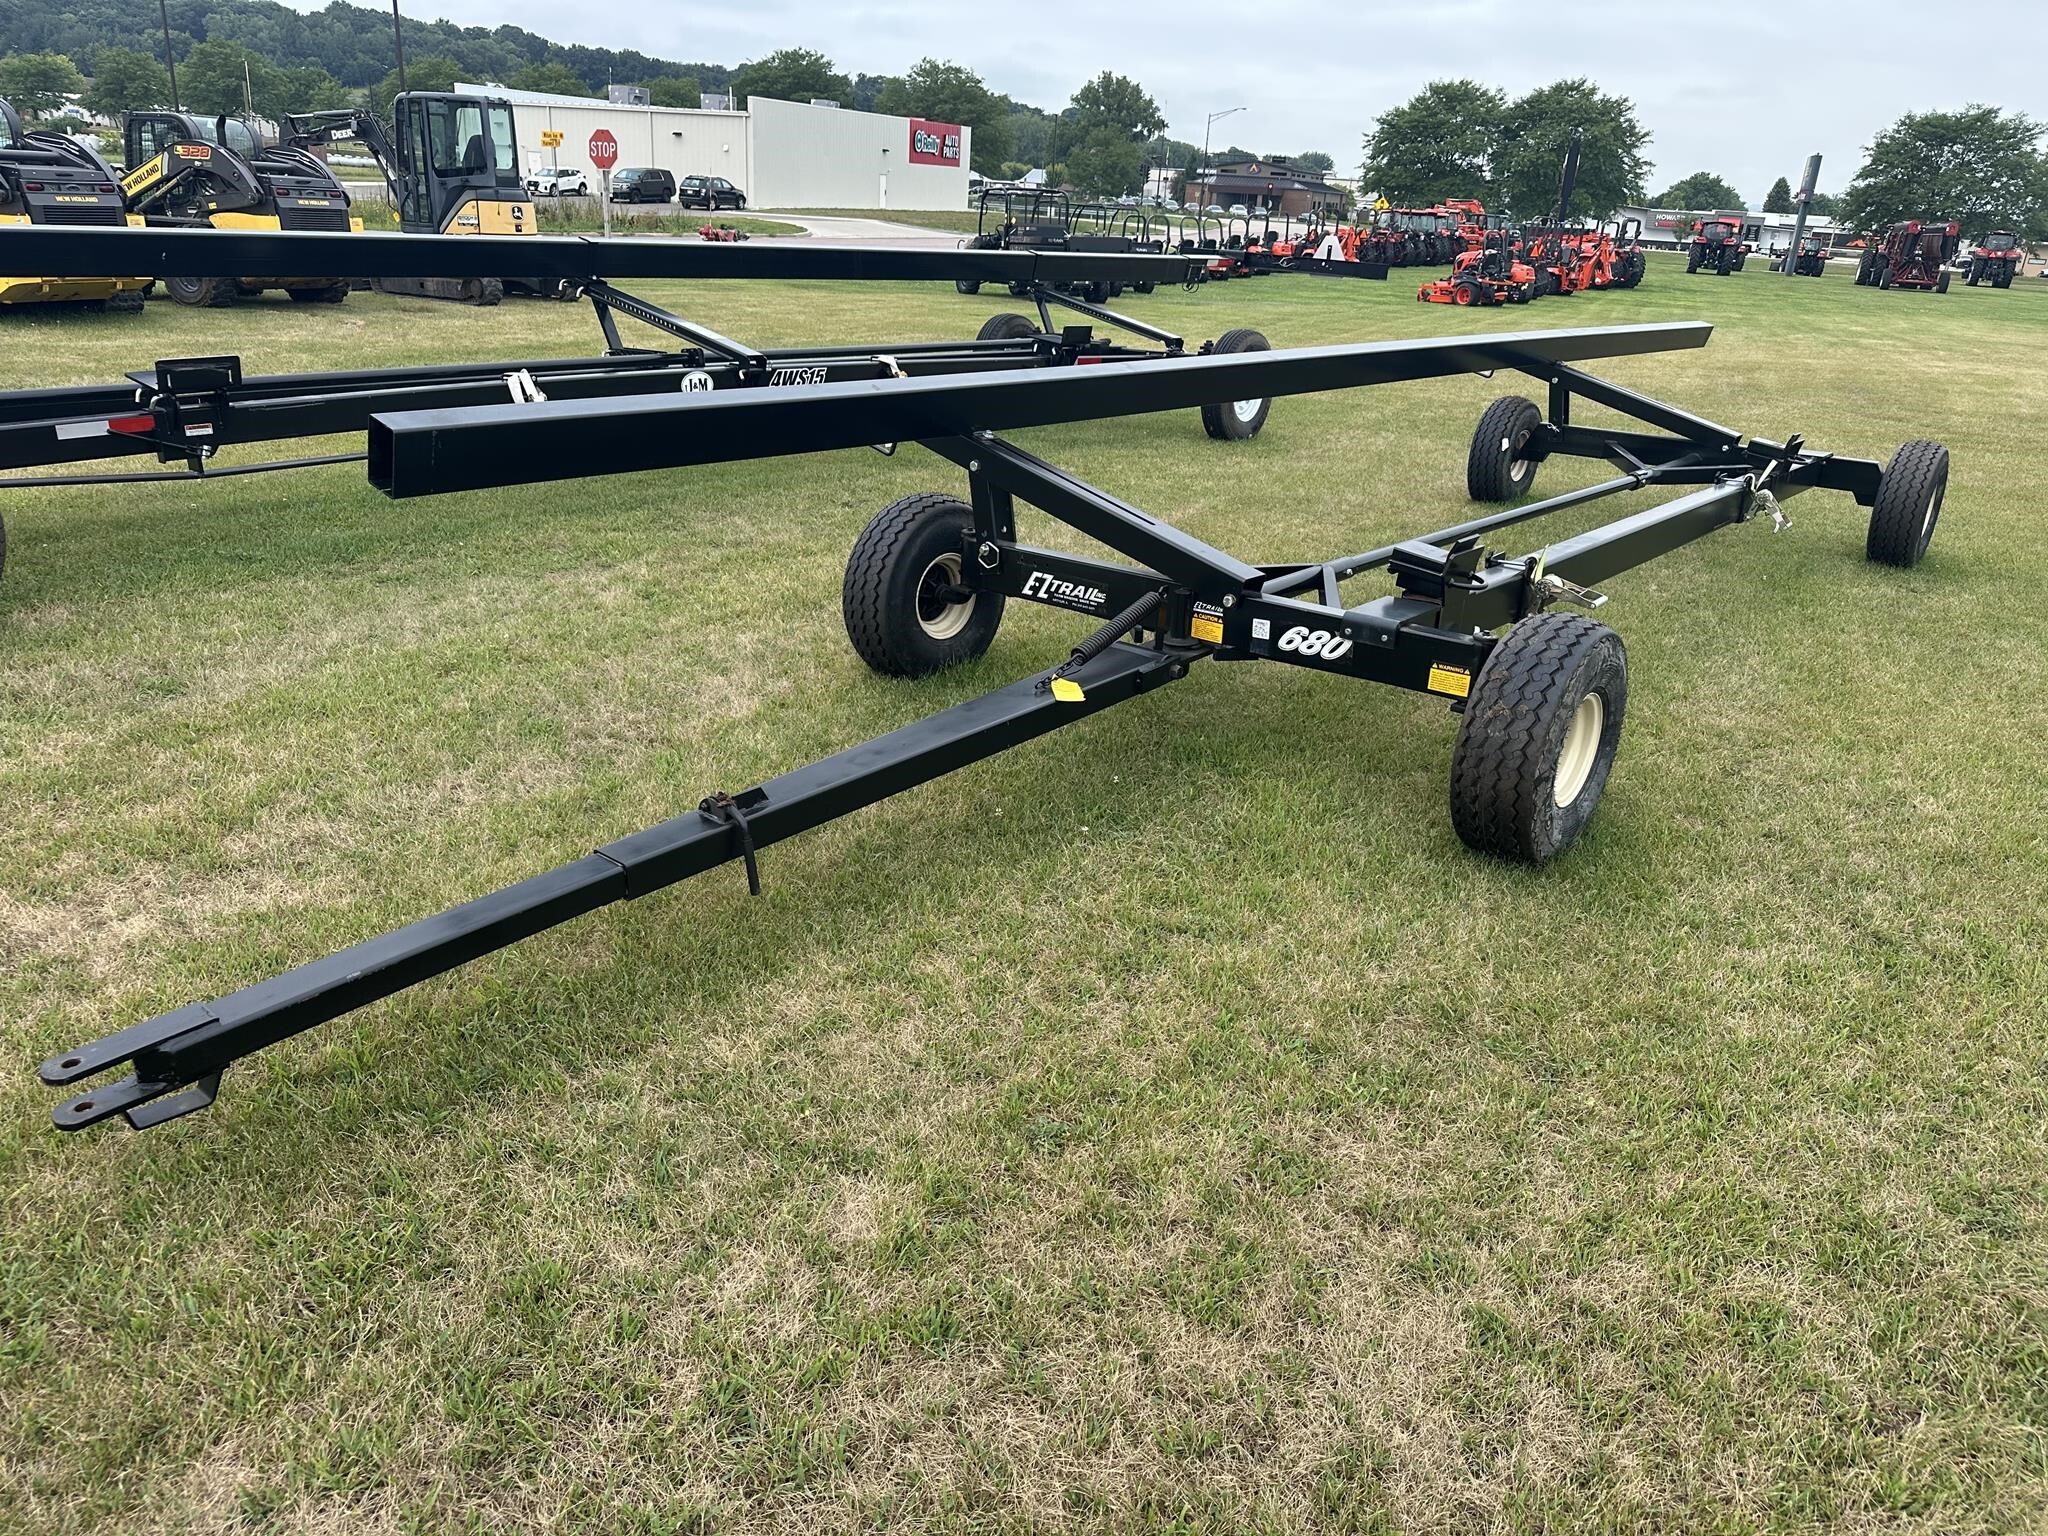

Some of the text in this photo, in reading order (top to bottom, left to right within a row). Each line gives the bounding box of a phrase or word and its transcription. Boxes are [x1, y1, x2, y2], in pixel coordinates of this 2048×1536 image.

[945, 134, 959, 147] AUTO
[591, 141, 616, 158] STOP
[943, 146, 960, 159] PARTS
[132, 163, 160, 187] HOLLAND
[769, 367, 828, 388] 4WS15
[1050, 579, 1106, 603] TRAIL
[1199, 613, 1219, 622] CAUTION
[1277, 625, 1353, 661] 680
[1438, 664, 1464, 674] WARNING
